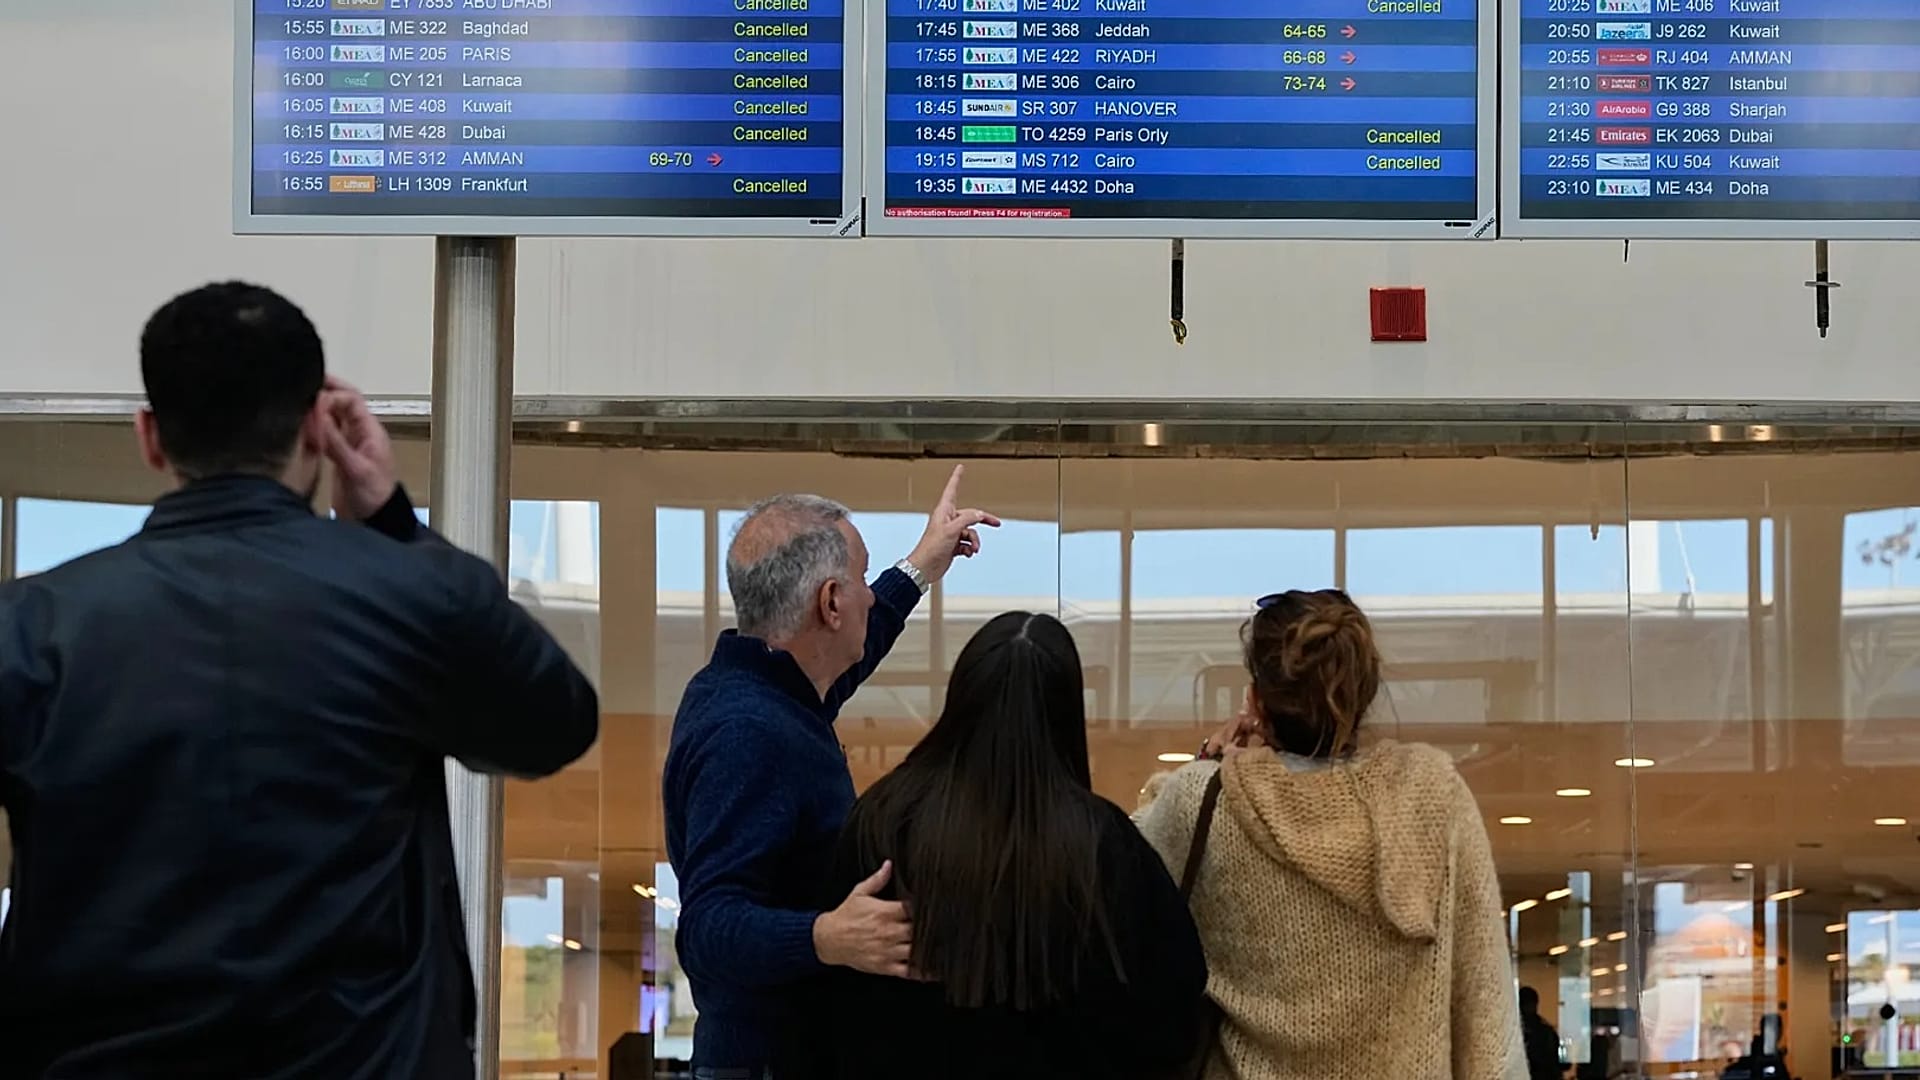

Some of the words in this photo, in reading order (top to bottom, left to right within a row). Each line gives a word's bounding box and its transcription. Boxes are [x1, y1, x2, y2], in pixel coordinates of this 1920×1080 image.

[286, 0, 325, 8] 15:20
[463, 0, 496, 9] ABU
[735, 0, 808, 10] Cancelled
[918, 0, 957, 10] 17:40
[1023, 0, 1047, 10] ME
[1052, 0, 1079, 10] 402
[1096, 0, 1145, 11] Kuwait
[1367, 0, 1440, 12] Cancelled
[1548, 0, 1590, 11] 20:25
[1656, 0, 1680, 12] ME
[1685, 0, 1714, 12] 406
[1730, 0, 1780, 12] Kuwait
[285, 21, 324, 34] 15:55
[343, 25, 372, 34] MEA
[390, 21, 414, 34] ME
[419, 21, 446, 34] 322
[463, 22, 528, 37] Baghdad
[734, 23, 807, 36] Cancelled
[916, 23, 956, 35] 17:45
[975, 27, 1004, 36] MEA
[1023, 23, 1046, 36] ME
[1051, 23, 1079, 36] 368
[1095, 24, 1149, 36] Jeddah
[1283, 25, 1325, 37] 64-65
[1548, 24, 1590, 37] 20:50
[1656, 24, 1673, 37] J9
[1678, 24, 1705, 37] 262
[1729, 25, 1779, 37] Kuwait
[284, 47, 323, 59] 16:00
[343, 51, 372, 60] MEA
[389, 47, 413, 60] ME
[419, 48, 446, 60] 205
[462, 48, 510, 60] PARIS
[734, 48, 807, 61] Cancelled
[916, 49, 956, 61] 17:55
[975, 53, 1004, 62] MEA
[1022, 49, 1046, 62] ME
[1051, 49, 1079, 62] 422
[1095, 50, 1155, 63] RiYADH
[1283, 51, 1325, 64] 66-68
[1548, 50, 1589, 63] 20:55
[1656, 51, 1675, 63] RJ
[1680, 51, 1707, 63] 404
[1728, 51, 1791, 64] AMMAN
[284, 73, 323, 85] 16:00
[389, 73, 412, 86] CY
[417, 73, 441, 86] 121
[462, 74, 521, 86] Larnaca
[734, 75, 807, 88] Cancelled
[915, 75, 956, 88] 18:15
[975, 79, 1004, 88] MEA
[1022, 75, 1046, 88] ME
[1051, 76, 1079, 88] 306
[1095, 76, 1135, 89] Cairo
[1283, 77, 1326, 89] 73-74
[1548, 77, 1589, 89] 21:10
[1655, 77, 1676, 89] TK
[1681, 77, 1709, 90] 827
[1730, 77, 1786, 89] Istanbul
[283, 99, 323, 111] 16:05
[342, 103, 371, 112] MEA
[389, 99, 413, 112] ME
[418, 100, 445, 112] 408
[462, 100, 511, 112] Kuwait
[733, 101, 807, 114] Cancelled
[916, 101, 955, 113] 18:45
[1022, 101, 1044, 114] SR
[1049, 102, 1077, 114] 307
[1095, 102, 1176, 115] HANOVER
[1548, 103, 1589, 115] 21:30
[1656, 103, 1677, 115] G9
[1682, 103, 1710, 115] 388
[1729, 103, 1786, 119] Sharjah
[284, 125, 323, 138] 16:15
[342, 129, 371, 138] MEA
[389, 126, 413, 138] ME
[418, 126, 445, 138] 428
[462, 126, 505, 138] Dubai
[733, 127, 806, 140] Cancelled
[915, 127, 955, 140] 18:45
[1021, 127, 1044, 141] TO
[1048, 128, 1085, 140] 4259
[1095, 128, 1133, 141] Paris
[1137, 128, 1168, 144] Orly
[1366, 129, 1440, 143] Cancelled
[1548, 129, 1589, 141] 21:45
[1601, 131, 1646, 141] Emirates
[1656, 129, 1678, 142] EK
[1682, 129, 1720, 142] 2063
[1729, 129, 1772, 142] Dubai
[283, 151, 323, 163] 16:25
[342, 155, 371, 164] MEA
[388, 152, 413, 164] ME
[418, 152, 445, 164] 312
[461, 152, 522, 164] AMMAN
[649, 153, 691, 165] 69-70
[915, 153, 955, 166] 19:15
[1022, 153, 1045, 167] MS
[1051, 154, 1078, 167] 712
[1094, 154, 1134, 167] Cairo
[1366, 156, 1439, 169] Cancelled
[1548, 155, 1589, 167] 22:55
[1656, 155, 1677, 168] KU
[1683, 155, 1710, 168] 504
[1729, 155, 1779, 168] Kuwait
[284, 177, 322, 190] 16:55
[388, 178, 409, 190] LH
[416, 178, 451, 190] 1309
[461, 178, 527, 191] Frankfurt
[733, 179, 806, 192] Cancelled
[915, 179, 955, 192] 19:35
[974, 183, 1003, 192] MEA
[1021, 180, 1045, 193] ME
[1050, 180, 1087, 193] 4432
[1095, 180, 1133, 193] Doha
[1548, 181, 1589, 194] 23:10
[1609, 185, 1638, 194] MEA
[1656, 181, 1680, 194] ME
[1684, 182, 1712, 194] 434
[1729, 182, 1768, 194] Doha
